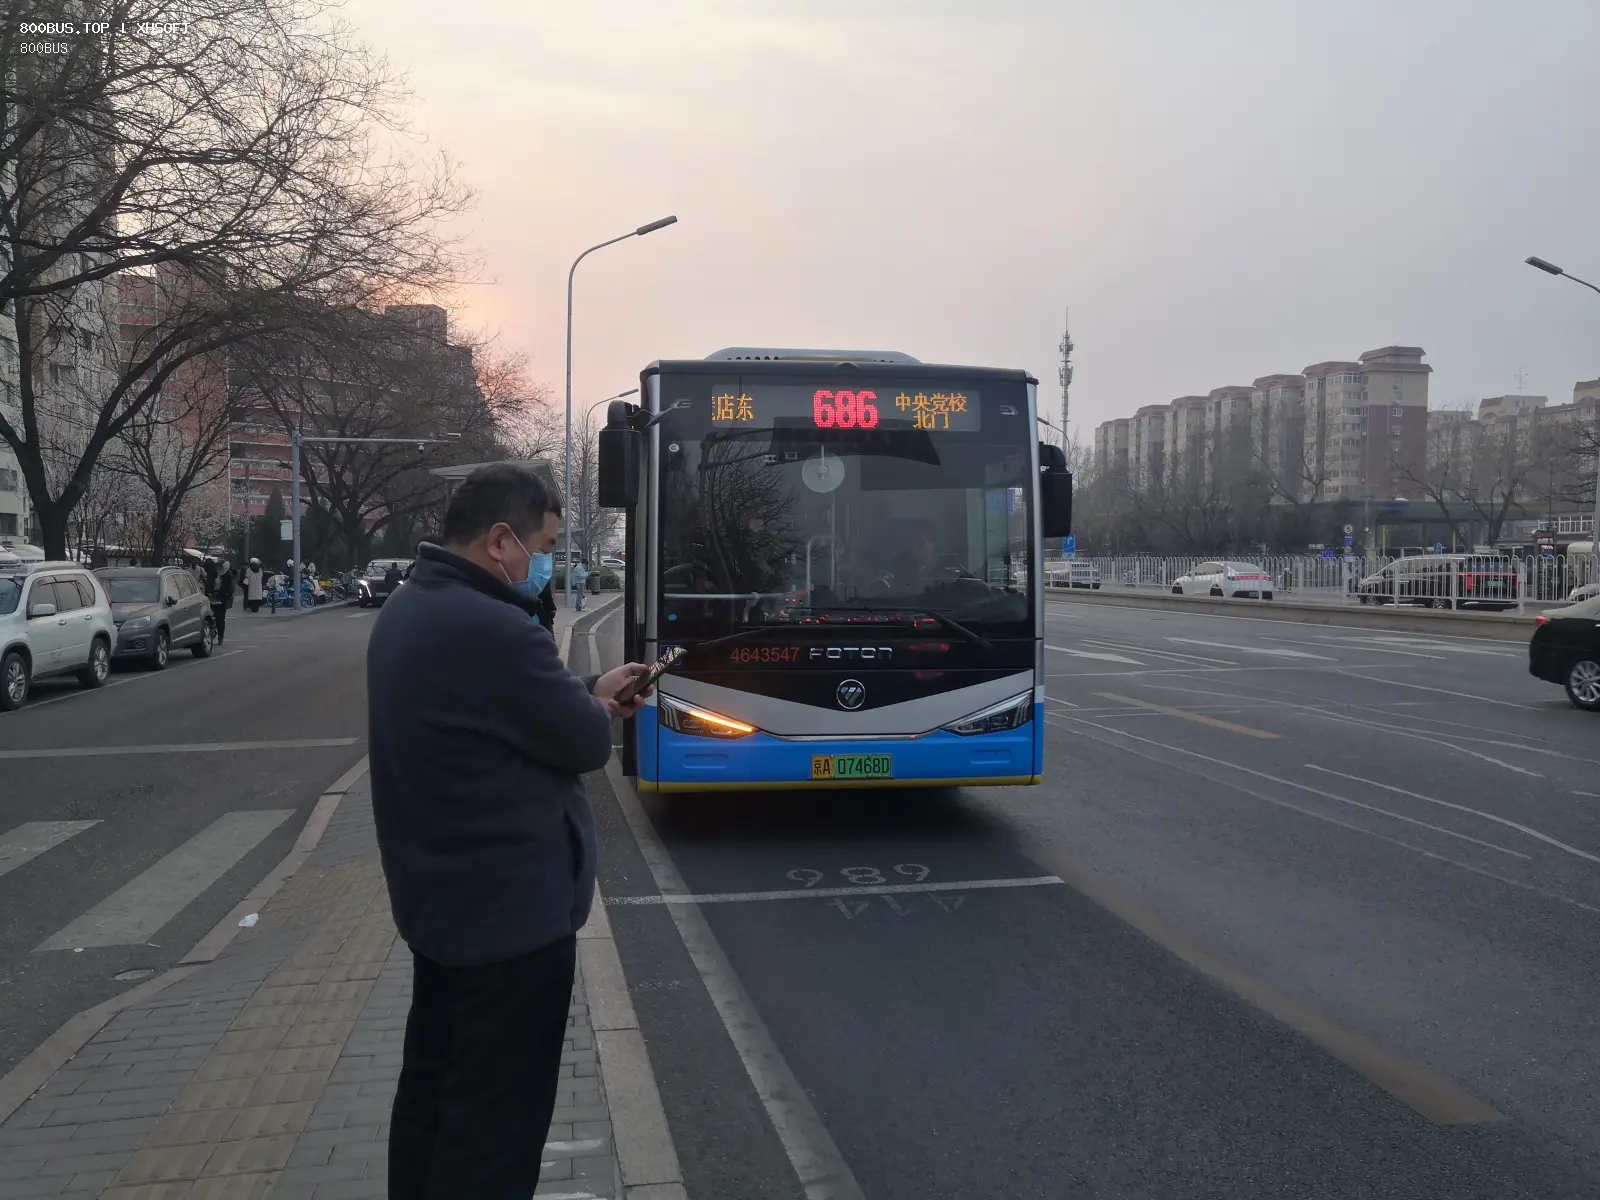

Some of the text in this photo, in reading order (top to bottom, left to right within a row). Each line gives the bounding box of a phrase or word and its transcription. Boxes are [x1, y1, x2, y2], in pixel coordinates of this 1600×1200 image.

[711, 392, 754, 421] 店东
[813, 389, 879, 429] 686
[895, 392, 968, 413] 中央党校
[912, 411, 950, 429] 北门
[730, 646, 800, 663] 4643547
[809, 646, 893, 660] FOTON
